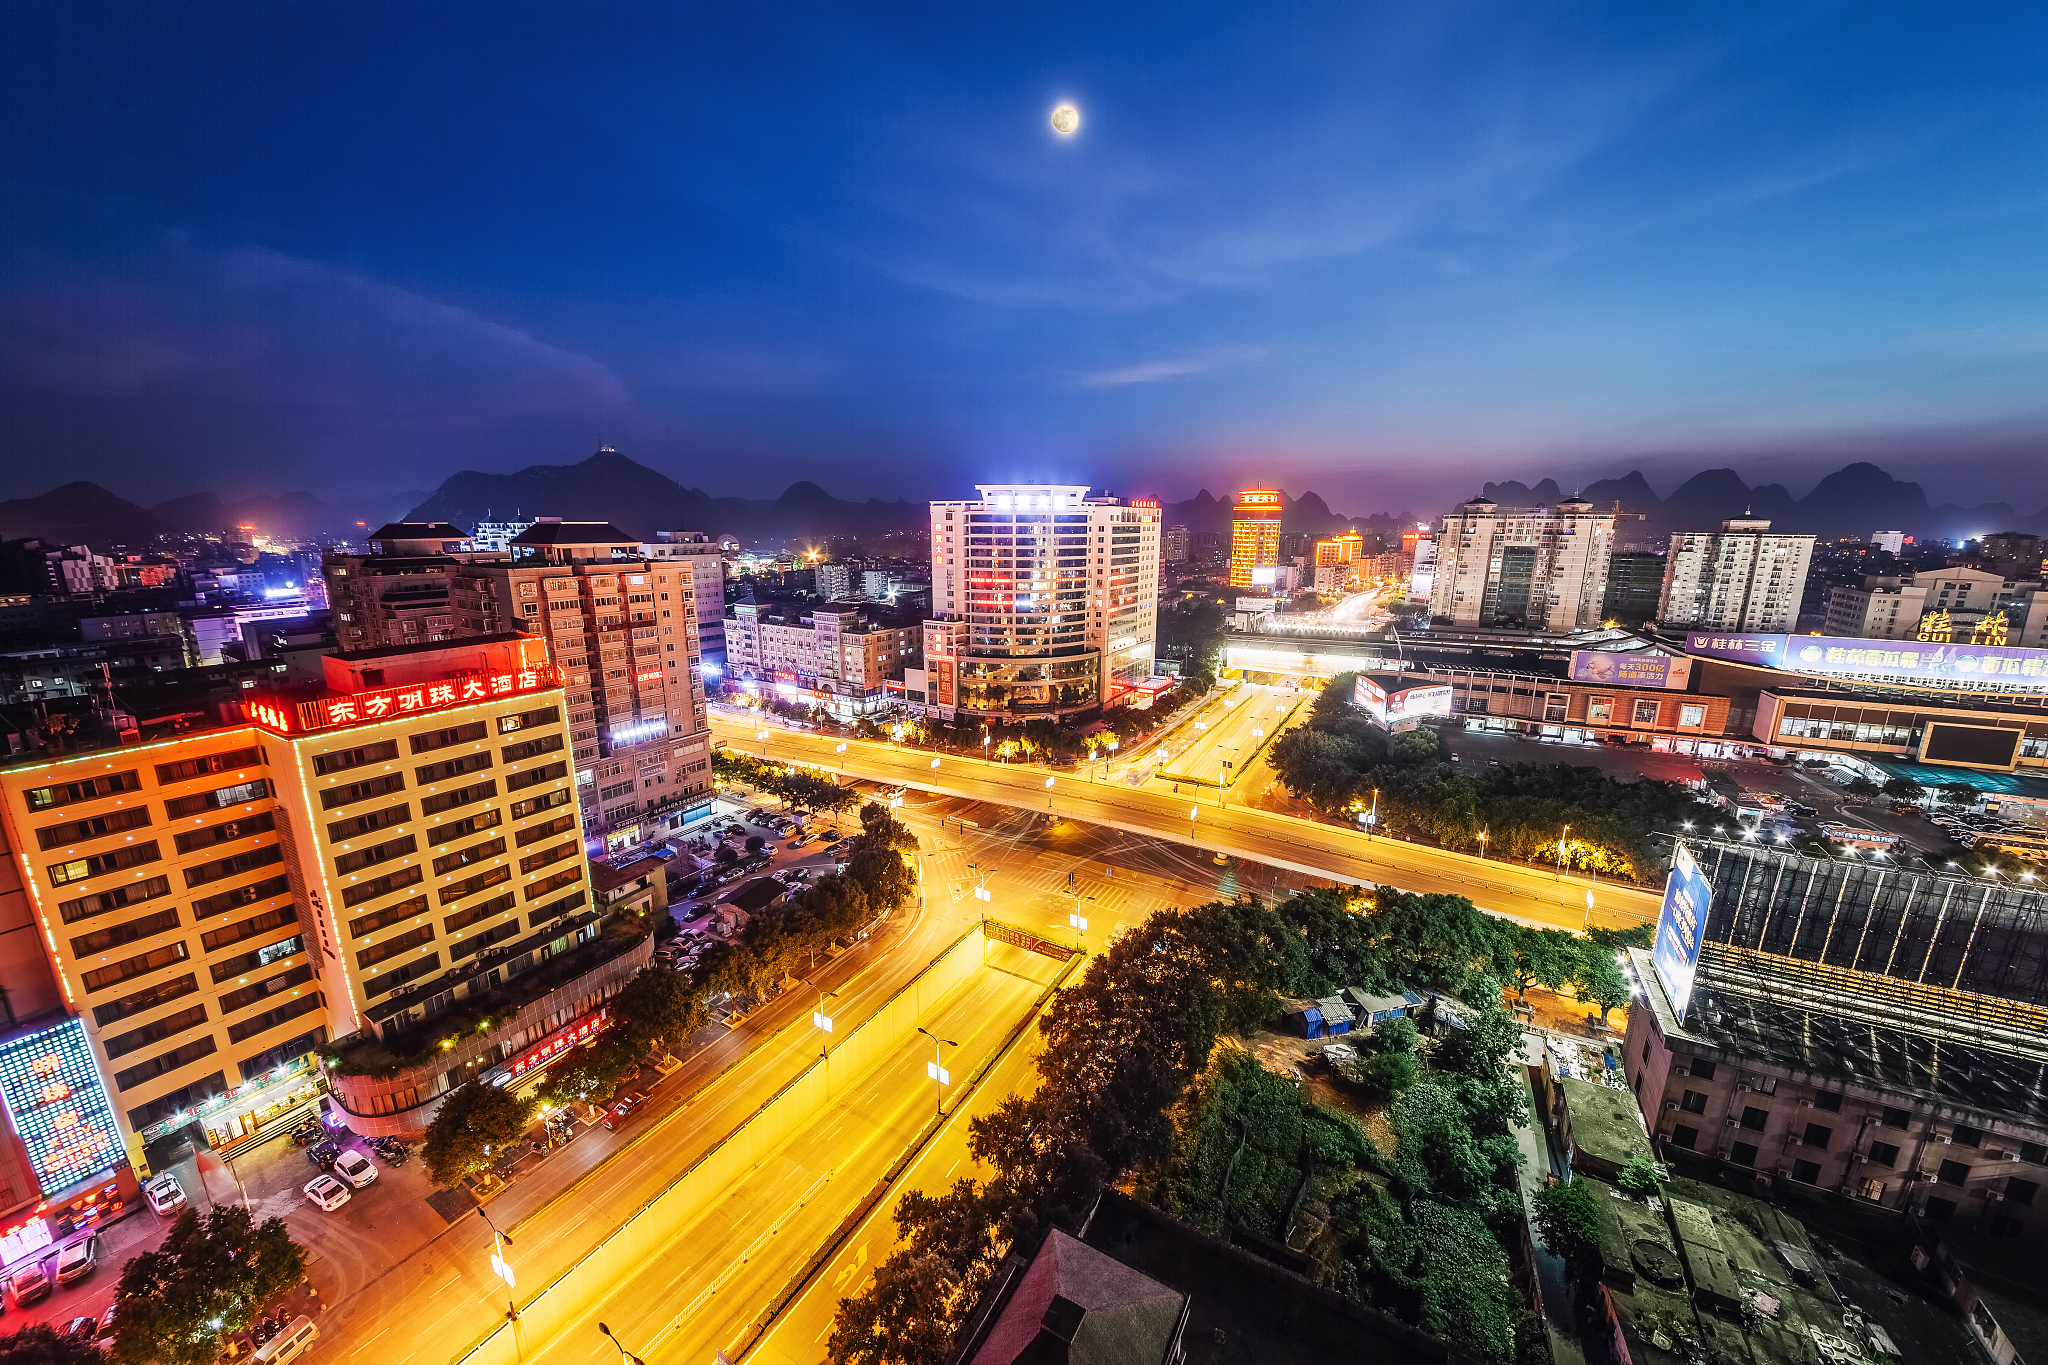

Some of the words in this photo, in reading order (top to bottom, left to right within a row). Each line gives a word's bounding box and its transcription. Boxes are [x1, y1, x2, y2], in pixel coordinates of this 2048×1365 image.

[1711, 638, 1777, 653] 桂林三金
[1916, 632, 1951, 643] GUI
[1971, 635, 2007, 646] LIN
[1618, 670, 1664, 680] 肠道添活力
[1619, 662, 1665, 673] 每天300亿
[940, 662, 951, 692] 售楼部
[328, 671, 538, 723] 东方明珠大酒店
[515, 1018, 601, 1073] 东方明珠大酒店
